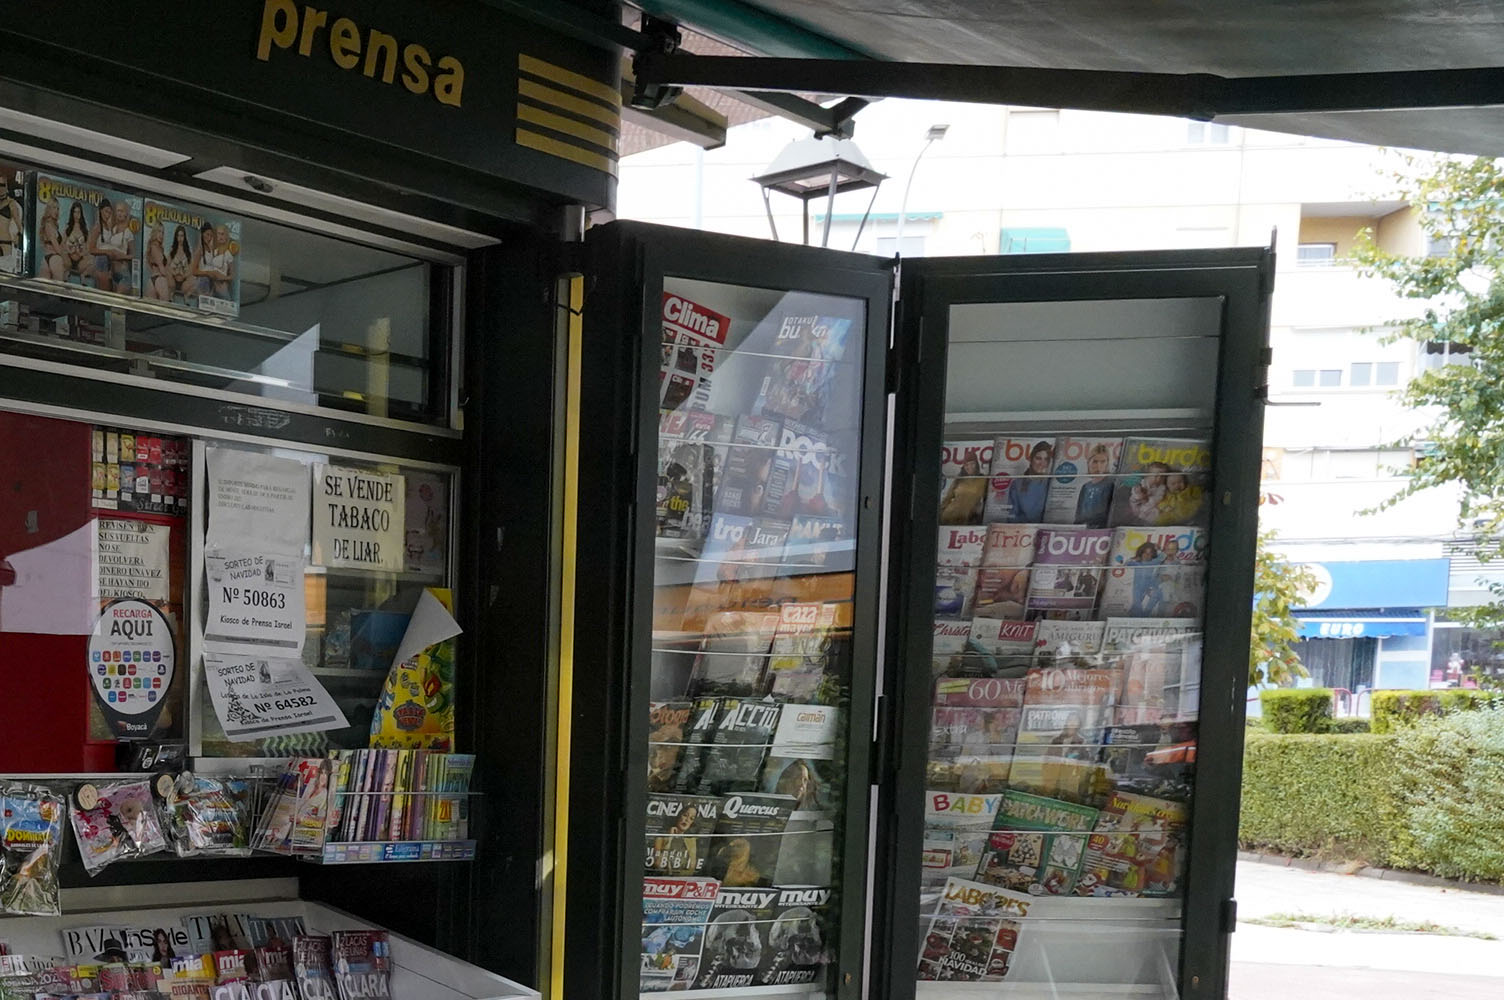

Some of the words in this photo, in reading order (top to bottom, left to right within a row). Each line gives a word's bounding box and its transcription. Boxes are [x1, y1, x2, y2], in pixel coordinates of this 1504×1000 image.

[255, 0, 466, 108] prensa
[663, 296, 720, 340] Clima
[324, 475, 343, 497] SE
[347, 475, 394, 503] VENDE
[328, 504, 390, 532] TABACO
[333, 539, 351, 560] DE
[352, 540, 384, 565] LIAR.
[224, 558, 253, 571] SORTEO
[254, 556, 264, 565] DE
[230, 569, 262, 581] NAVIDAD
[243, 589, 286, 610] 50863
[113, 608, 153, 619] RECARGA
[220, 614, 240, 625] Kiosco
[242, 617, 250, 626] de
[252, 617, 273, 628] Prensa
[110, 619, 154, 640] AQUI
[1001, 623, 1034, 639] KNIT
[1320, 622, 1365, 636] EURO
[218, 664, 246, 677] SORTEO
[247, 662, 256, 672] DE
[224, 674, 256, 688] NAVIDAD
[274, 695, 318, 712] 64582
[721, 796, 780, 819] Quercus
[932, 793, 995, 815] BABY
[717, 889, 778, 908] muy
[344, 973, 389, 998] CLARA
